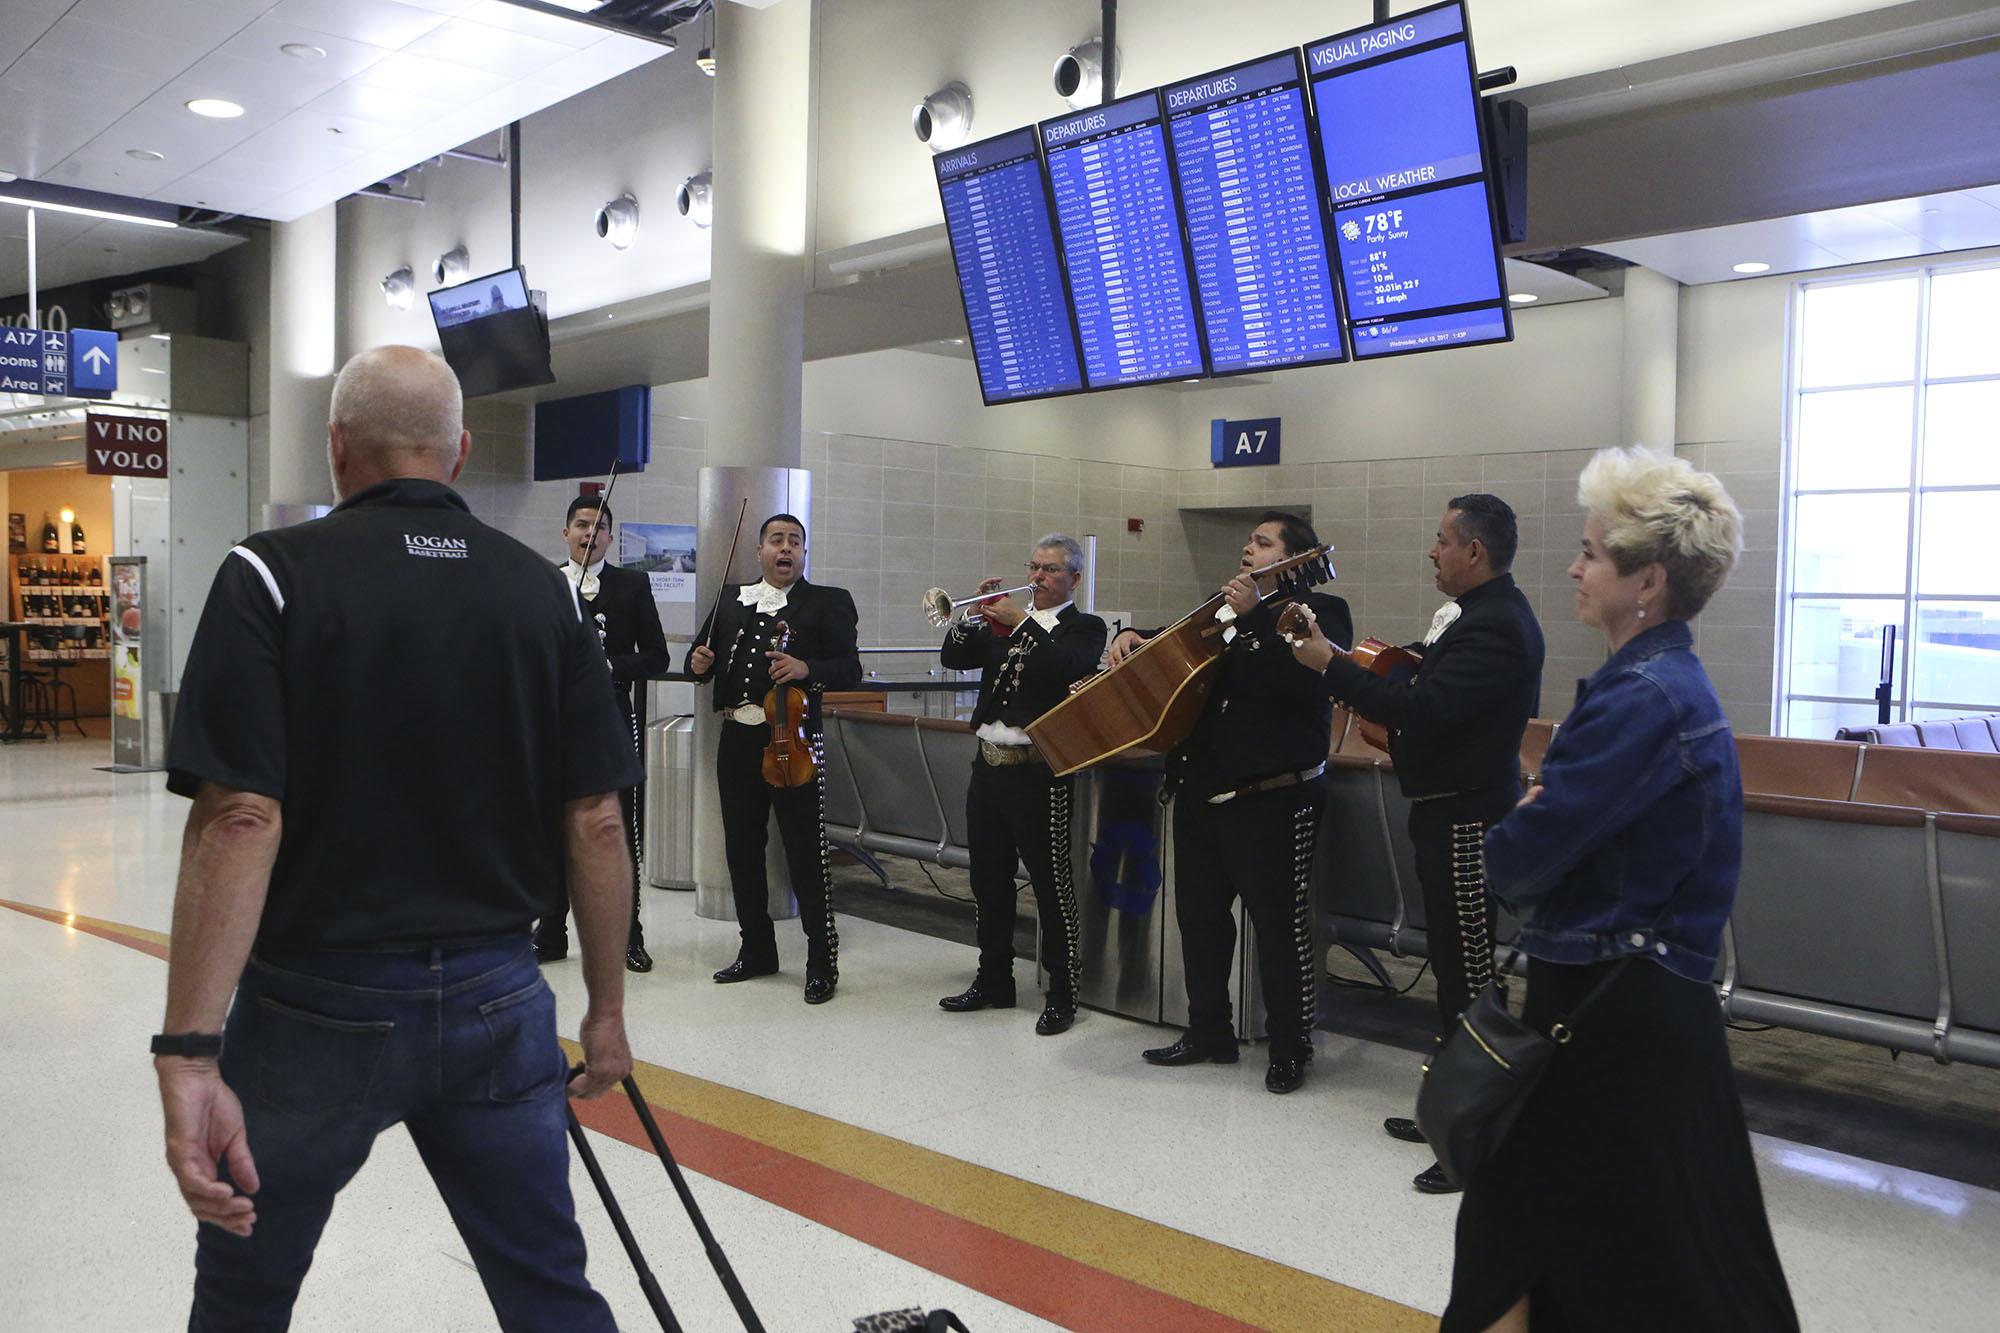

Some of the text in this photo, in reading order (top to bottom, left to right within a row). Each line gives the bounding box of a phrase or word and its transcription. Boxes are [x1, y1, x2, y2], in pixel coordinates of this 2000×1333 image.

[1313, 24, 1415, 66] VISUAL PAGING
[1168, 76, 1237, 108] DEPARTURES
[1046, 114, 1106, 142] DEPARTURES
[940, 152, 978, 174] ARRIVALS
[1335, 166, 1436, 199] LOCAL WEATHER
[1367, 229, 1409, 244] Partly Sunny
[1371, 263, 1388, 273] 61%
[1373, 272, 1394, 283] 10 mi
[1376, 293, 1407, 305] SE 6mph
[5, 331, 37, 345] A17
[1418, 336, 1429, 344] April
[1, 376, 38, 390] Area
[94, 422, 162, 442] VINO
[1235, 431, 1267, 454] A7
[95, 450, 163, 470] VOLO
[403, 534, 467, 549] LOGAN
[408, 548, 468, 558] BASKETBALL
